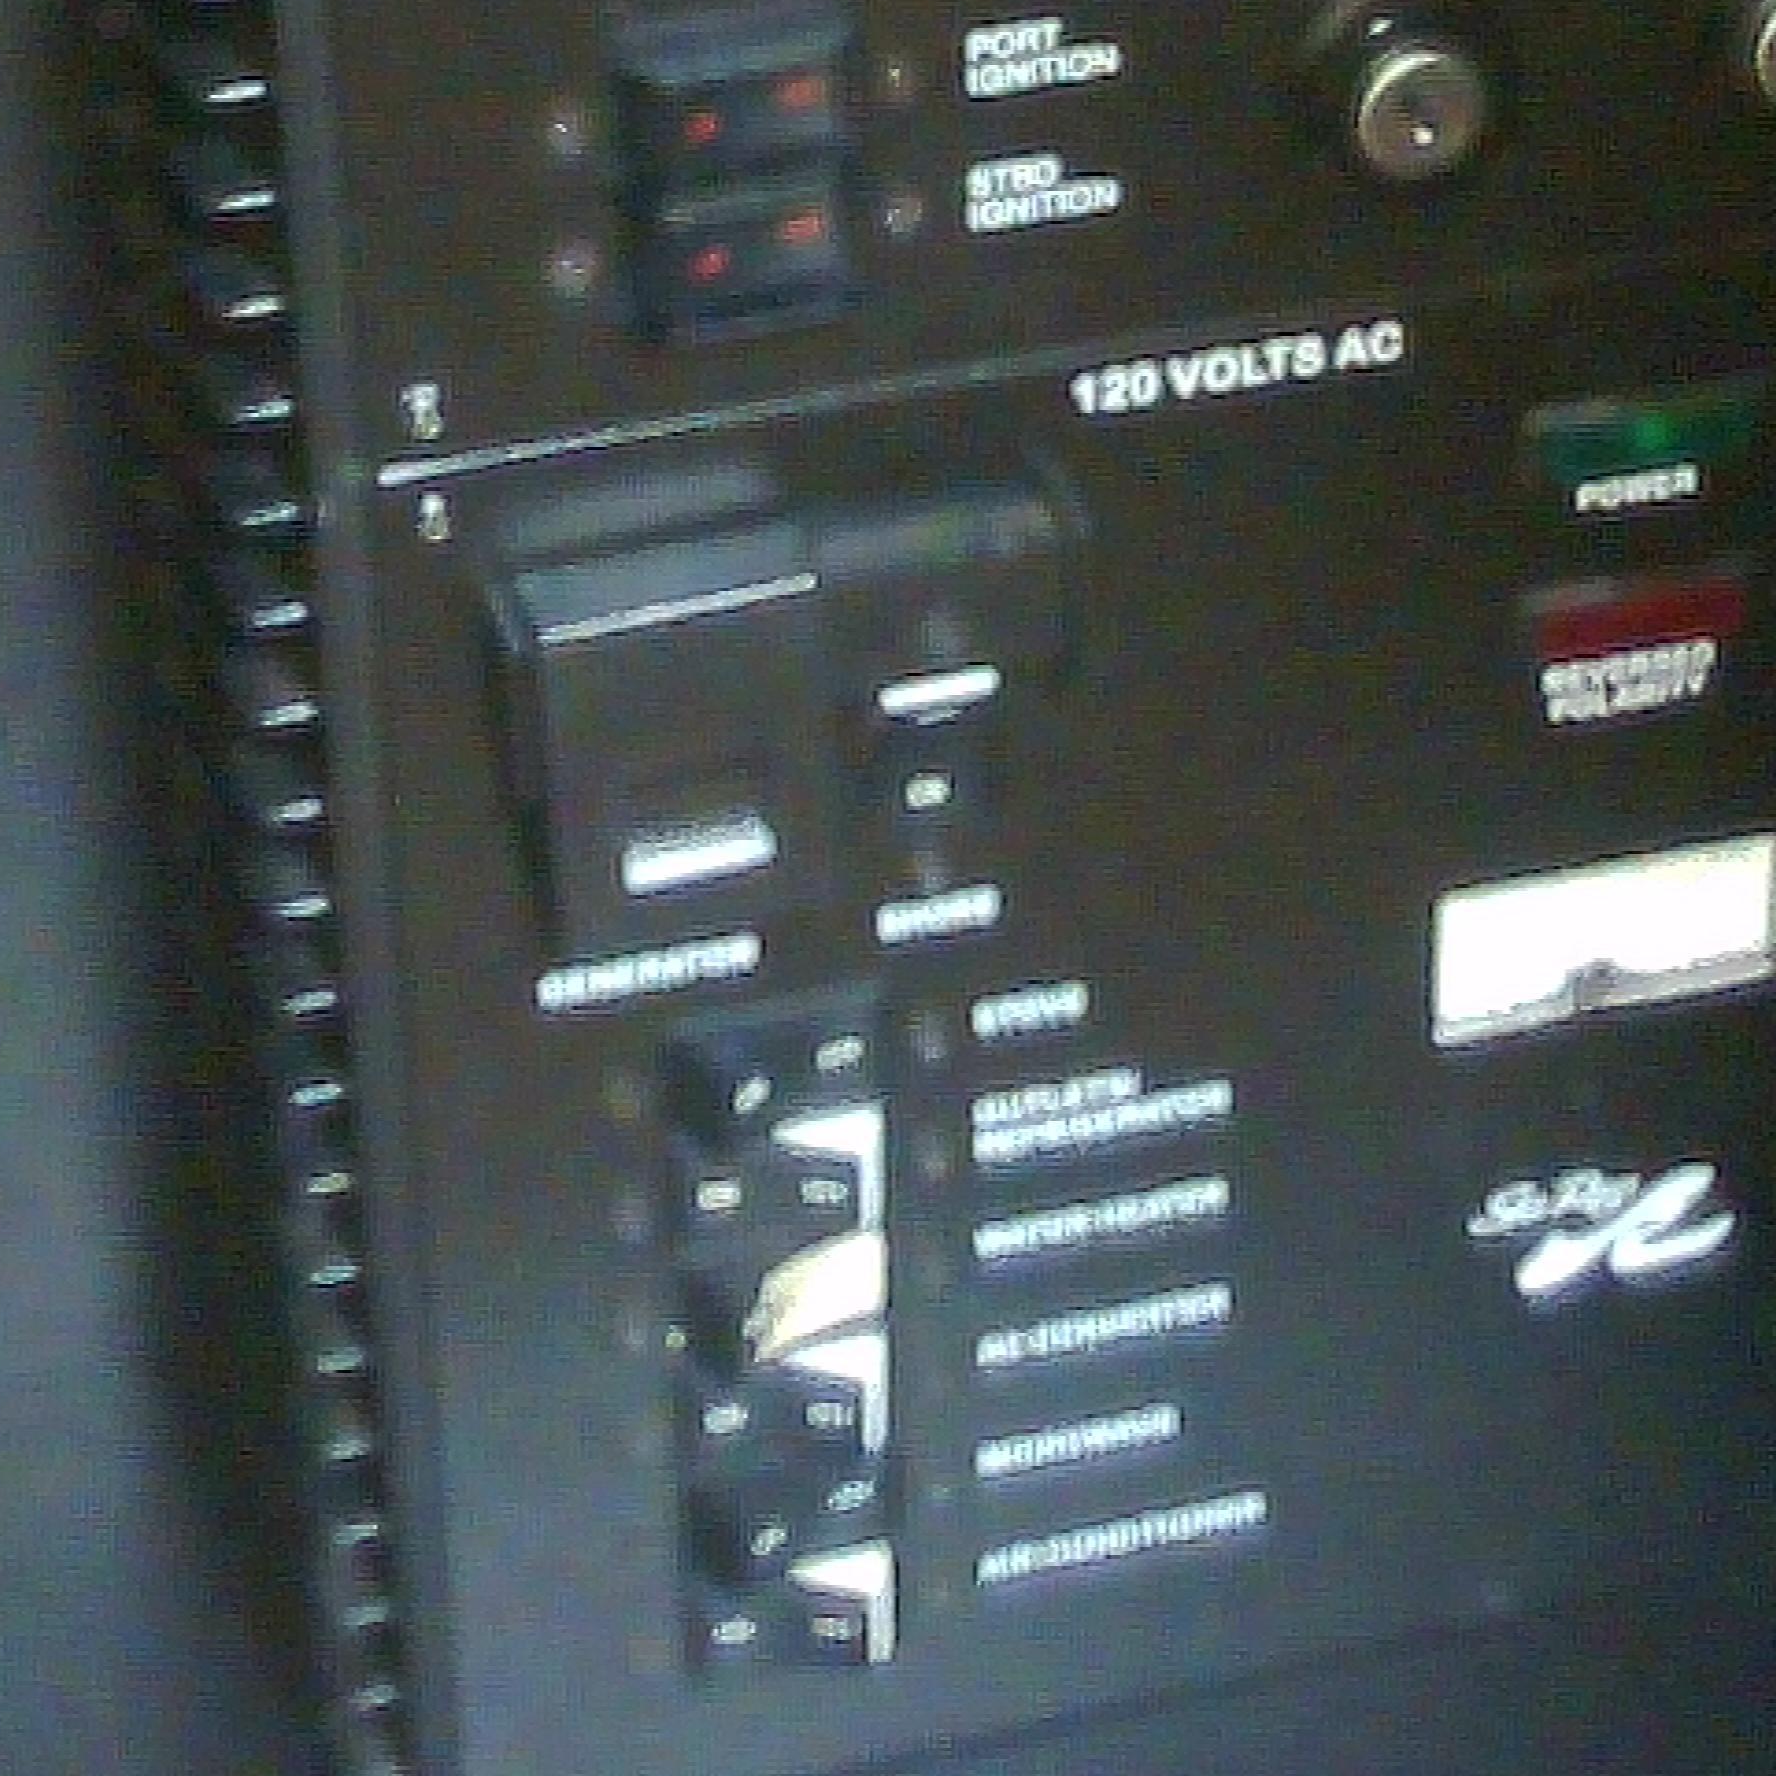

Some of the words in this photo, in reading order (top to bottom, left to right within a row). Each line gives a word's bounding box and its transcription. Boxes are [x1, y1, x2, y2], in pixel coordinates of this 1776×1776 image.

[965, 18, 1063, 63] PORT
[965, 44, 1121, 100] IGNITION
[967, 177, 1121, 233] IGNITION
[1070, 361, 1160, 416] 120
[1166, 332, 1327, 401] VOLTS
[1333, 319, 1405, 373] AC
